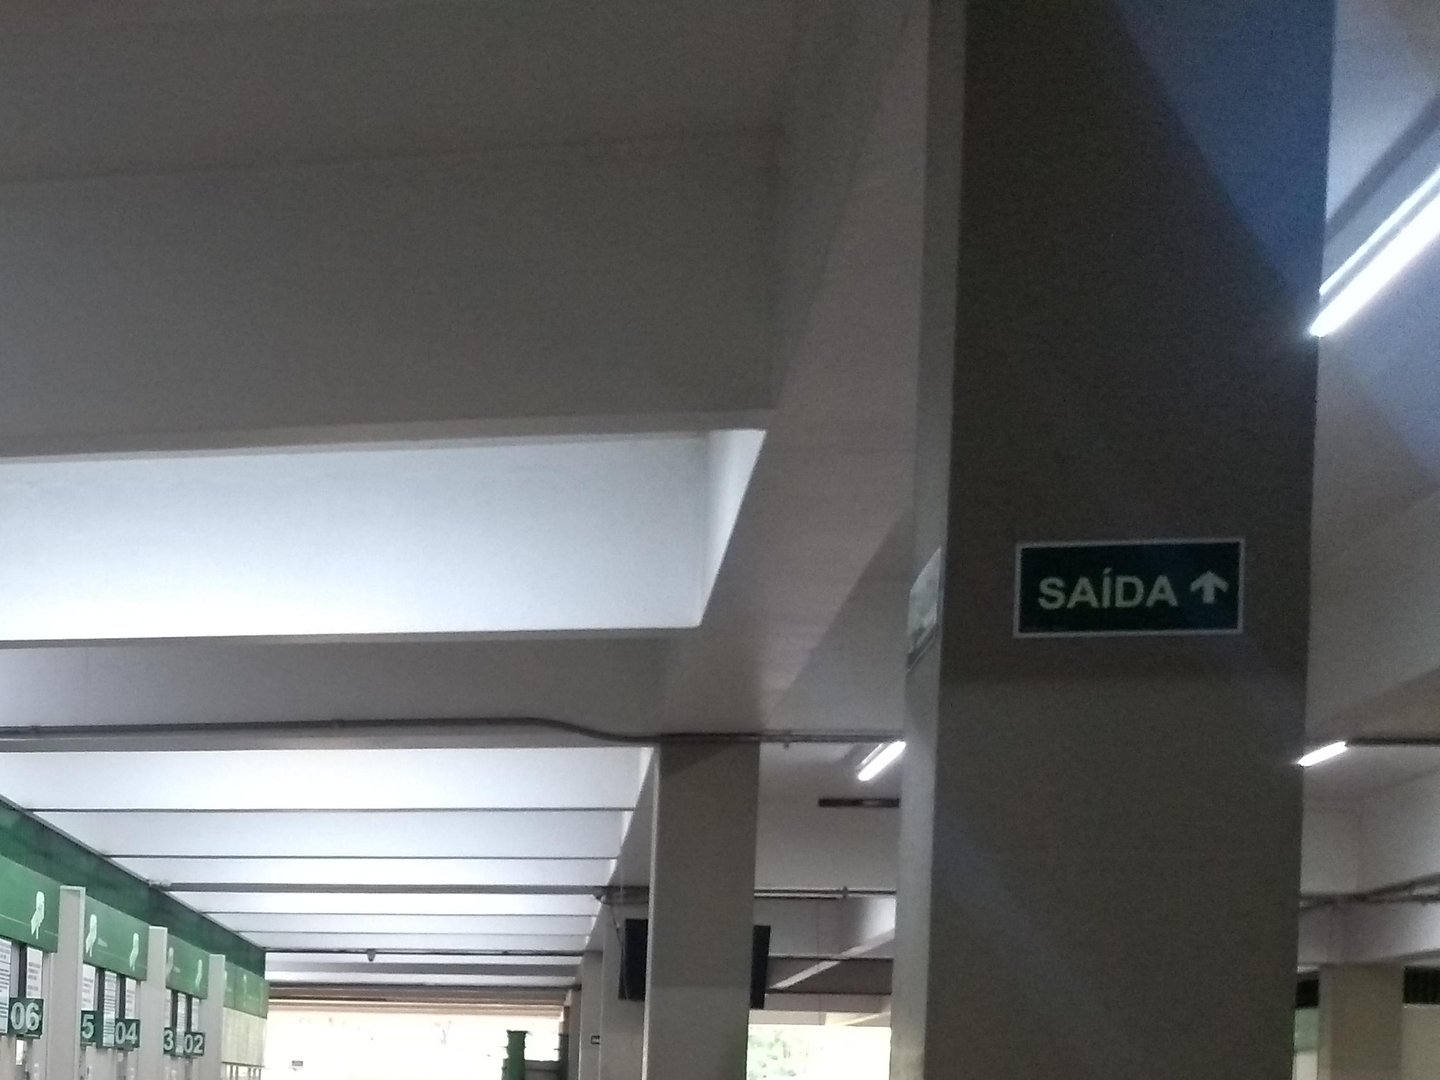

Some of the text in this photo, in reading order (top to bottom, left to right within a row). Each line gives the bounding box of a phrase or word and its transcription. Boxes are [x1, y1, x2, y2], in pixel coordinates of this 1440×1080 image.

[1038, 567, 1179, 610] SAÍDA
[10, 1001, 41, 1031] 06
[115, 1022, 138, 1045] 04
[184, 1034, 204, 1054] 02
